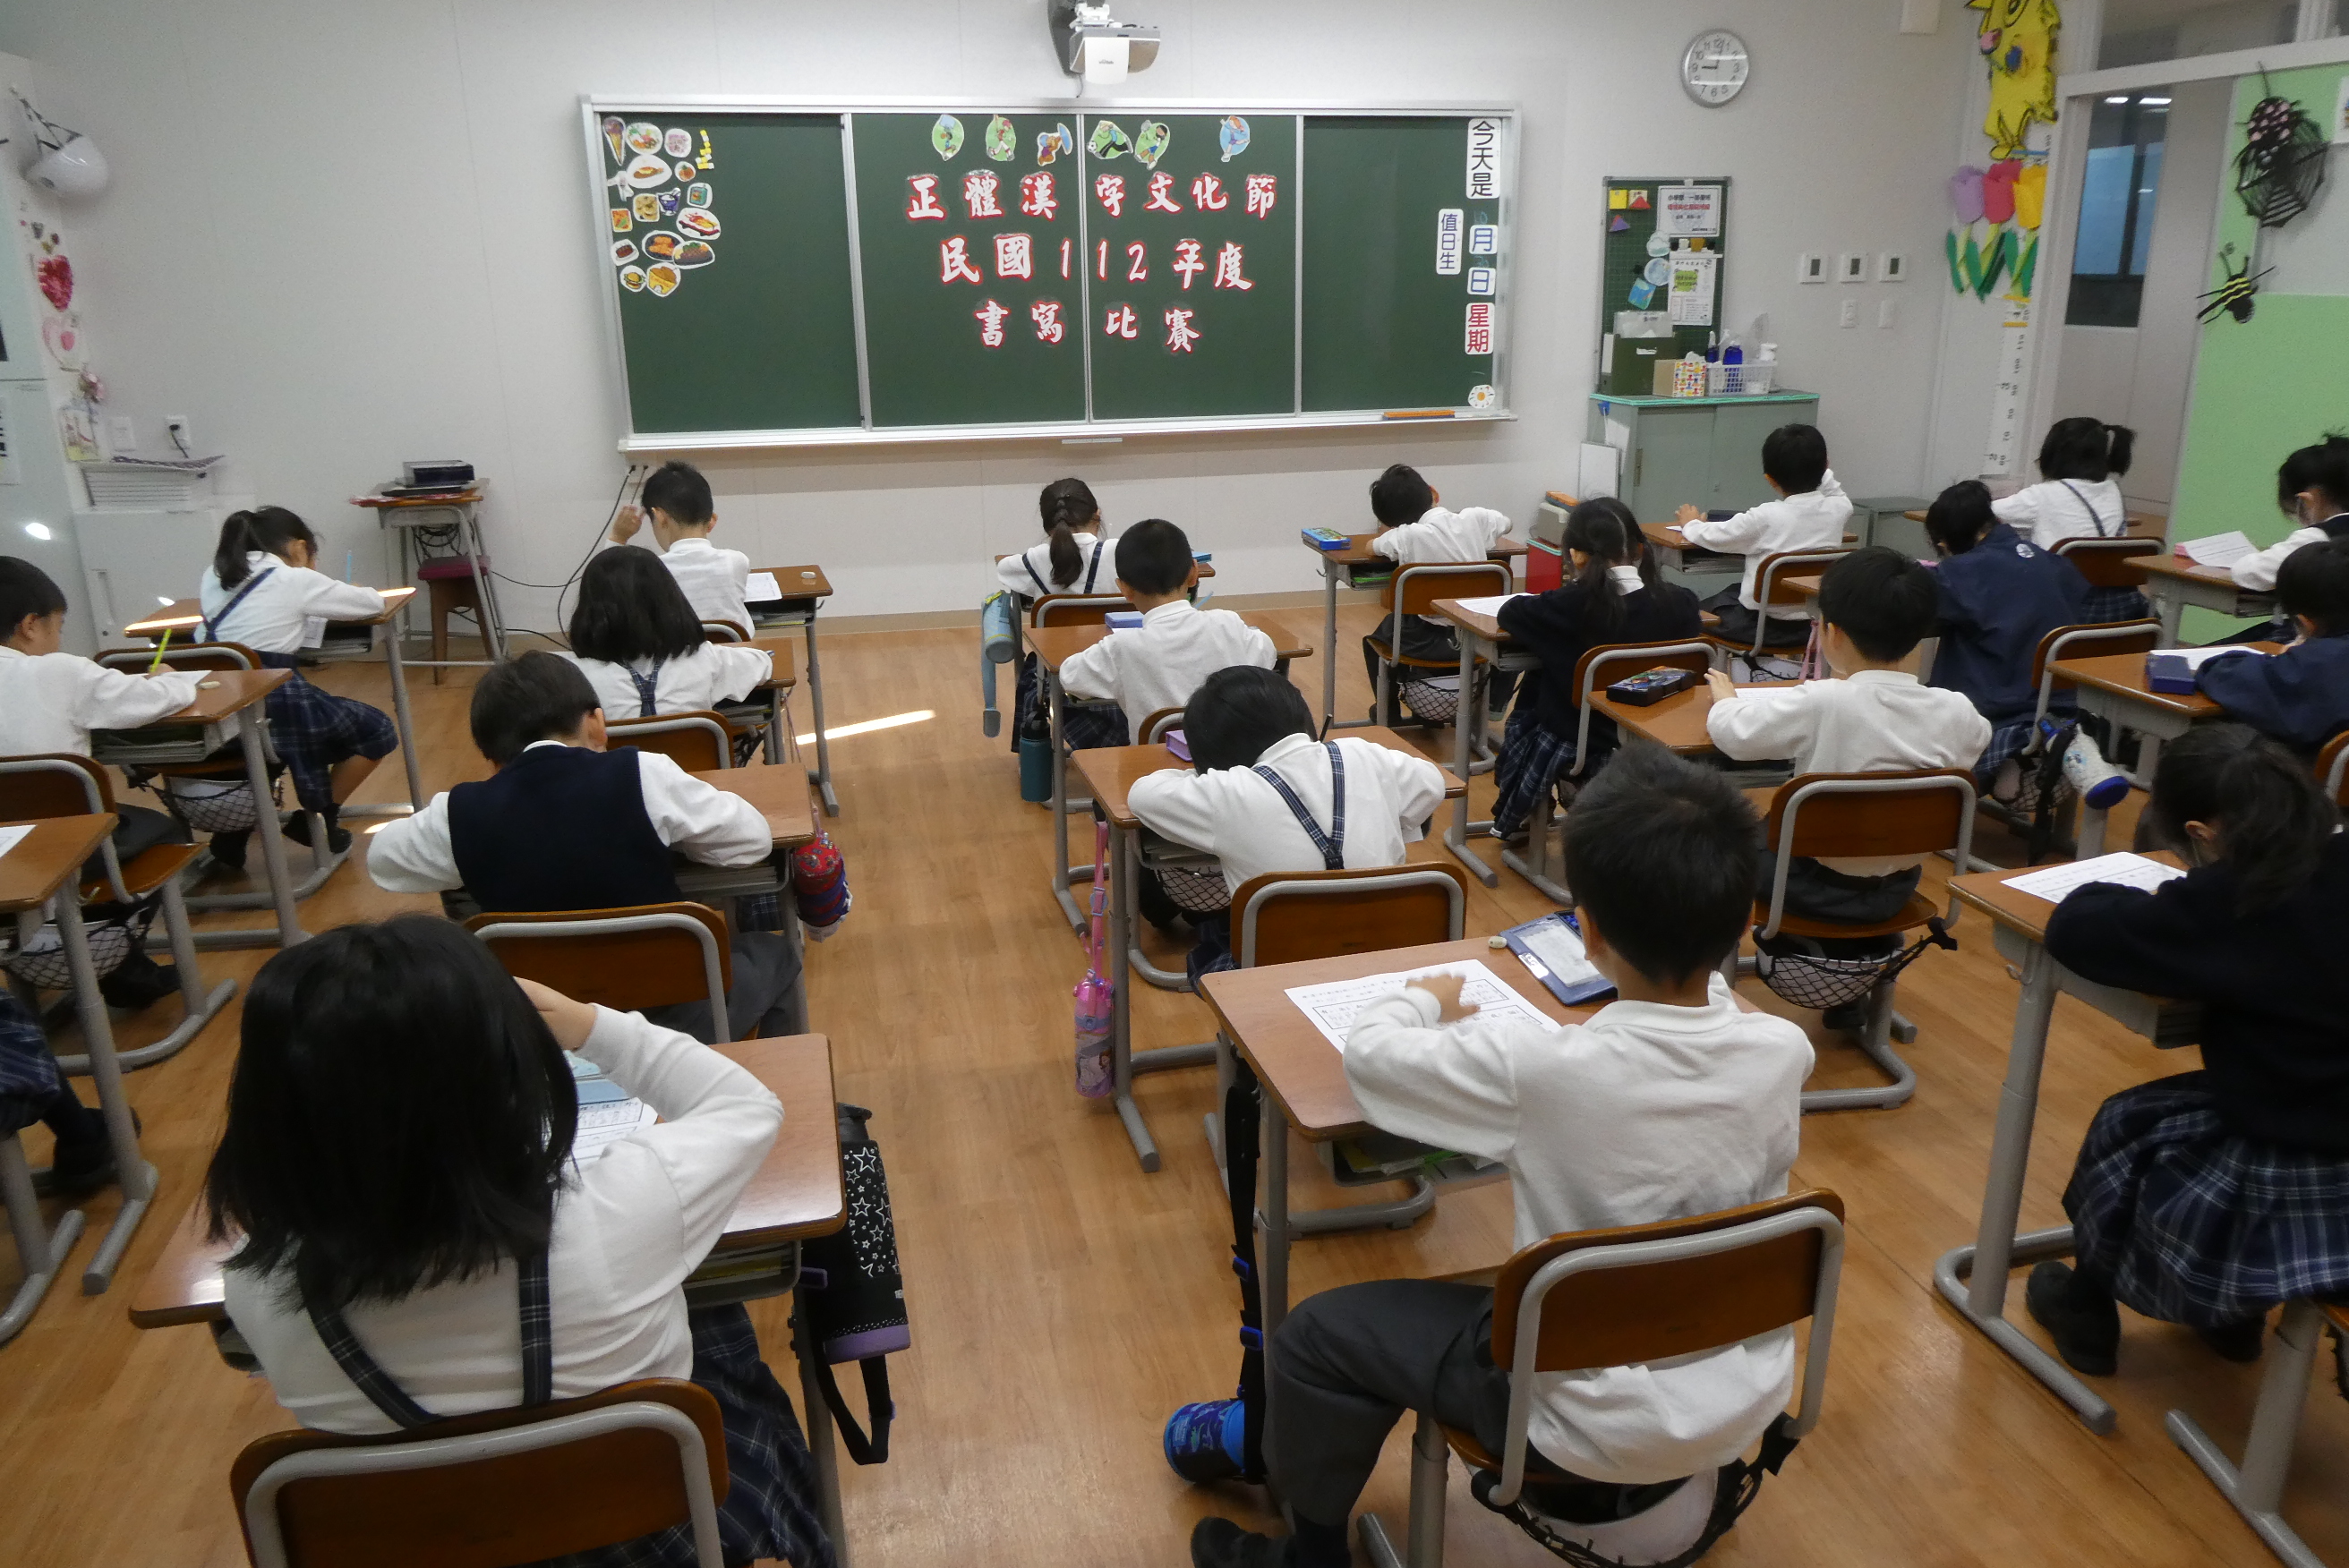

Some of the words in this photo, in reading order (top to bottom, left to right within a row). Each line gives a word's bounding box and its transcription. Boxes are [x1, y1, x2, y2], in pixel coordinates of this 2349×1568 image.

[1472, 120, 1495, 197] 今天是
[906, 172, 1277, 219] 正體漢字文化節
[940, 233, 1253, 290] 民國112年度
[1439, 213, 1457, 269] 值日生
[1473, 227, 1493, 251] 月
[1471, 269, 1490, 293] 日
[974, 299, 1201, 354] 書寫比賽
[1467, 303, 1490, 354] 星期
